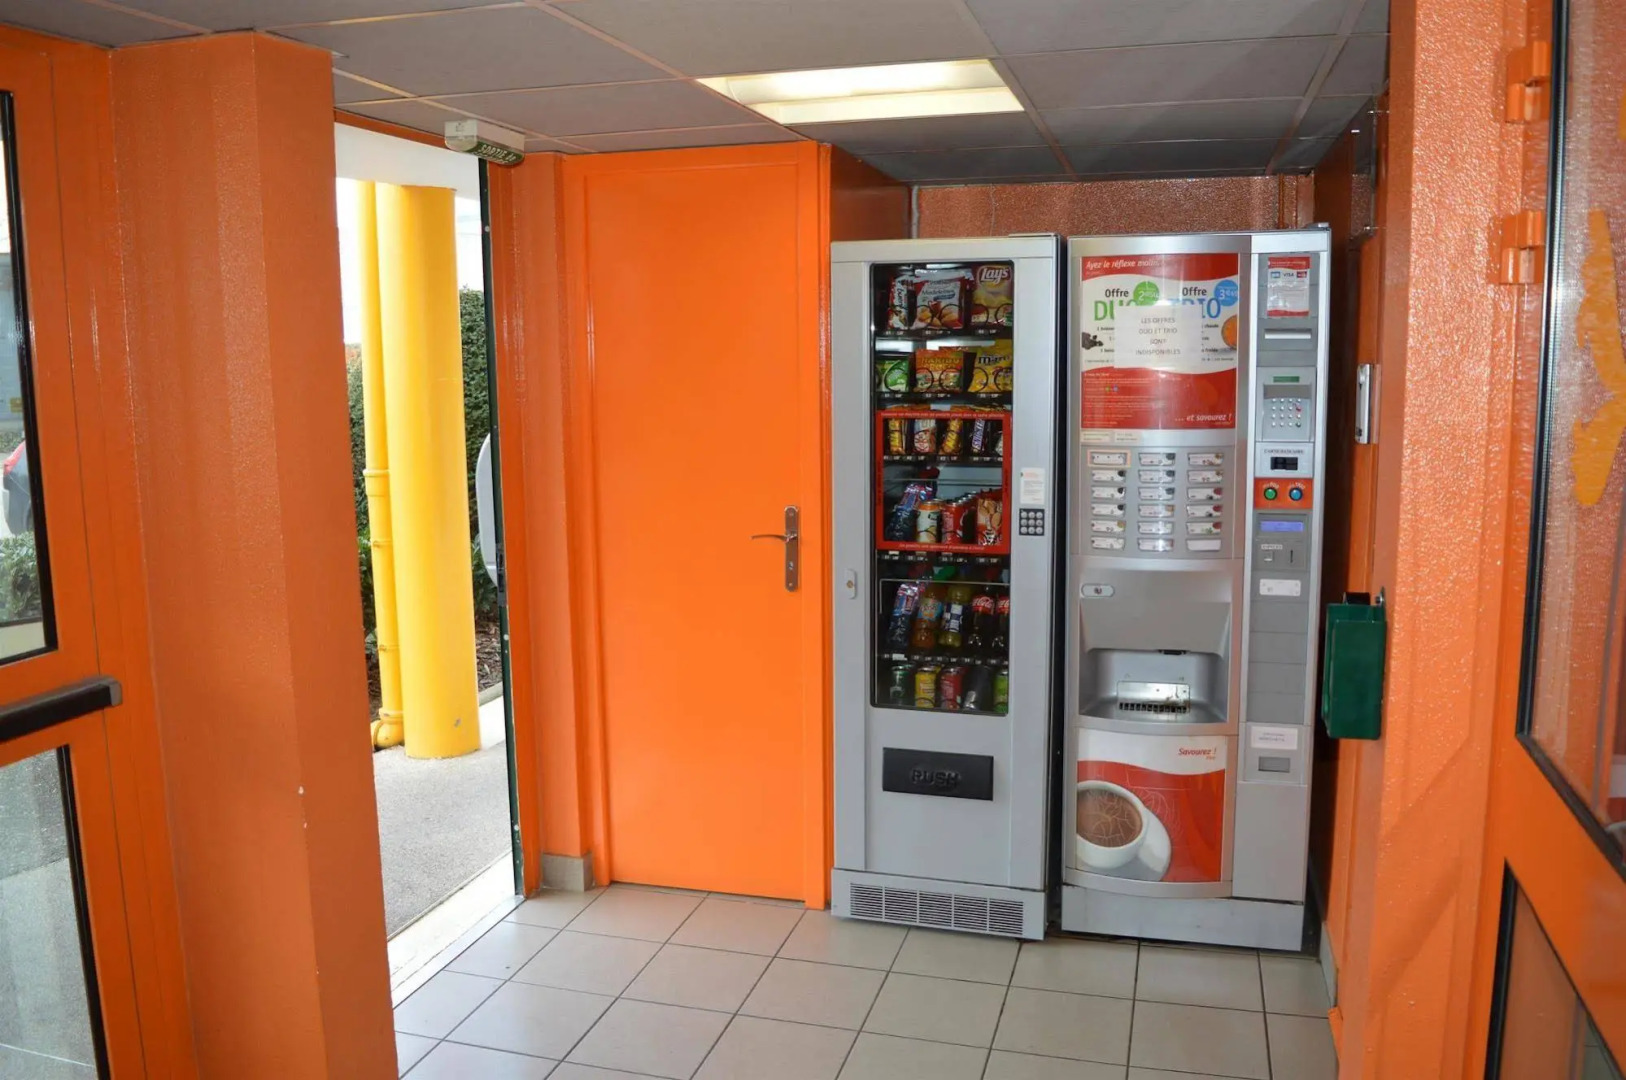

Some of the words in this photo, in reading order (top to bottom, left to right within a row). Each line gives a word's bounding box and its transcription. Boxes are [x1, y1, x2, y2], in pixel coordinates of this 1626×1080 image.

[478, 144, 508, 159] SORTIE
[1086, 259, 1101, 271] Ayez
[1103, 260, 1111, 268] le
[1112, 259, 1136, 270] réflexe
[1105, 287, 1130, 298] Offre
[1182, 286, 1208, 297] Offre
[1178, 747, 1211, 756] Savourez
[911, 768, 961, 787] PUSH
